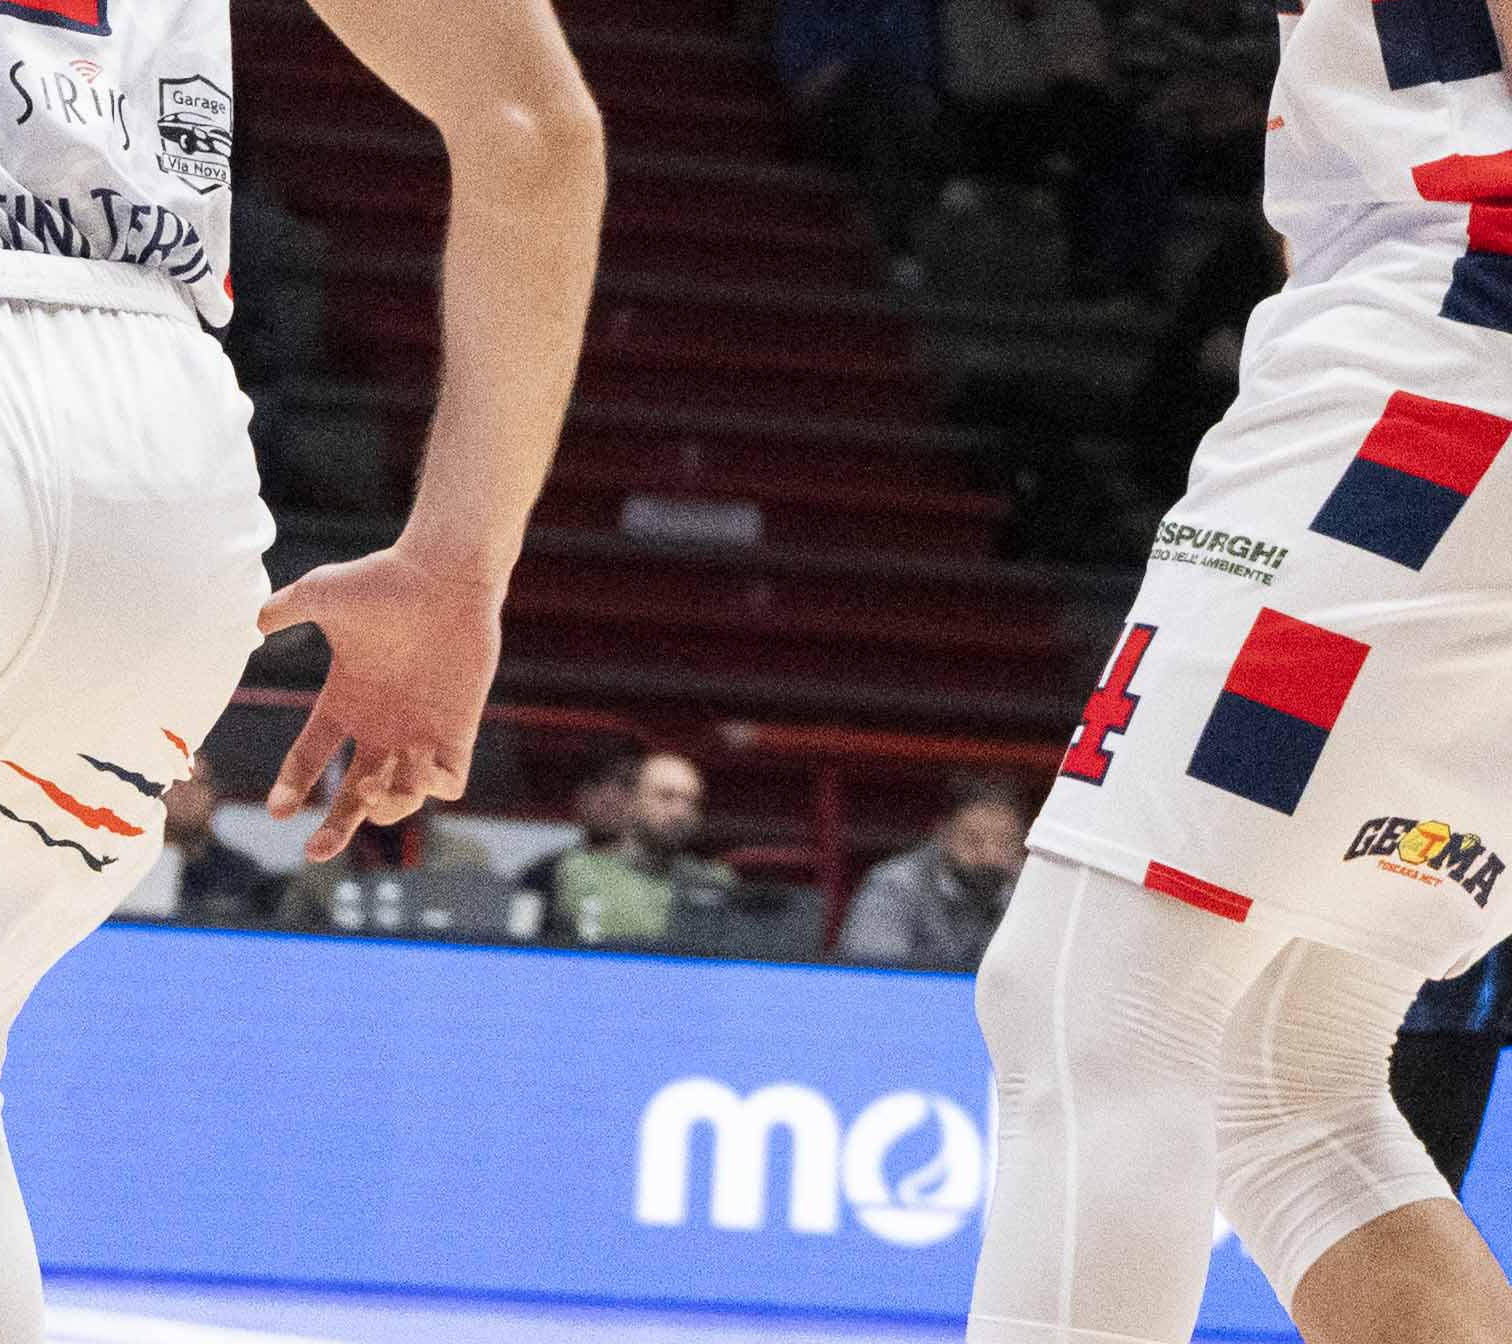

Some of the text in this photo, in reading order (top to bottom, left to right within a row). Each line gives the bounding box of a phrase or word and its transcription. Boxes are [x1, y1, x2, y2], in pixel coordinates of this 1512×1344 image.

[172, 90, 227, 115] Garage
[169, 157, 227, 179] Via Nova
